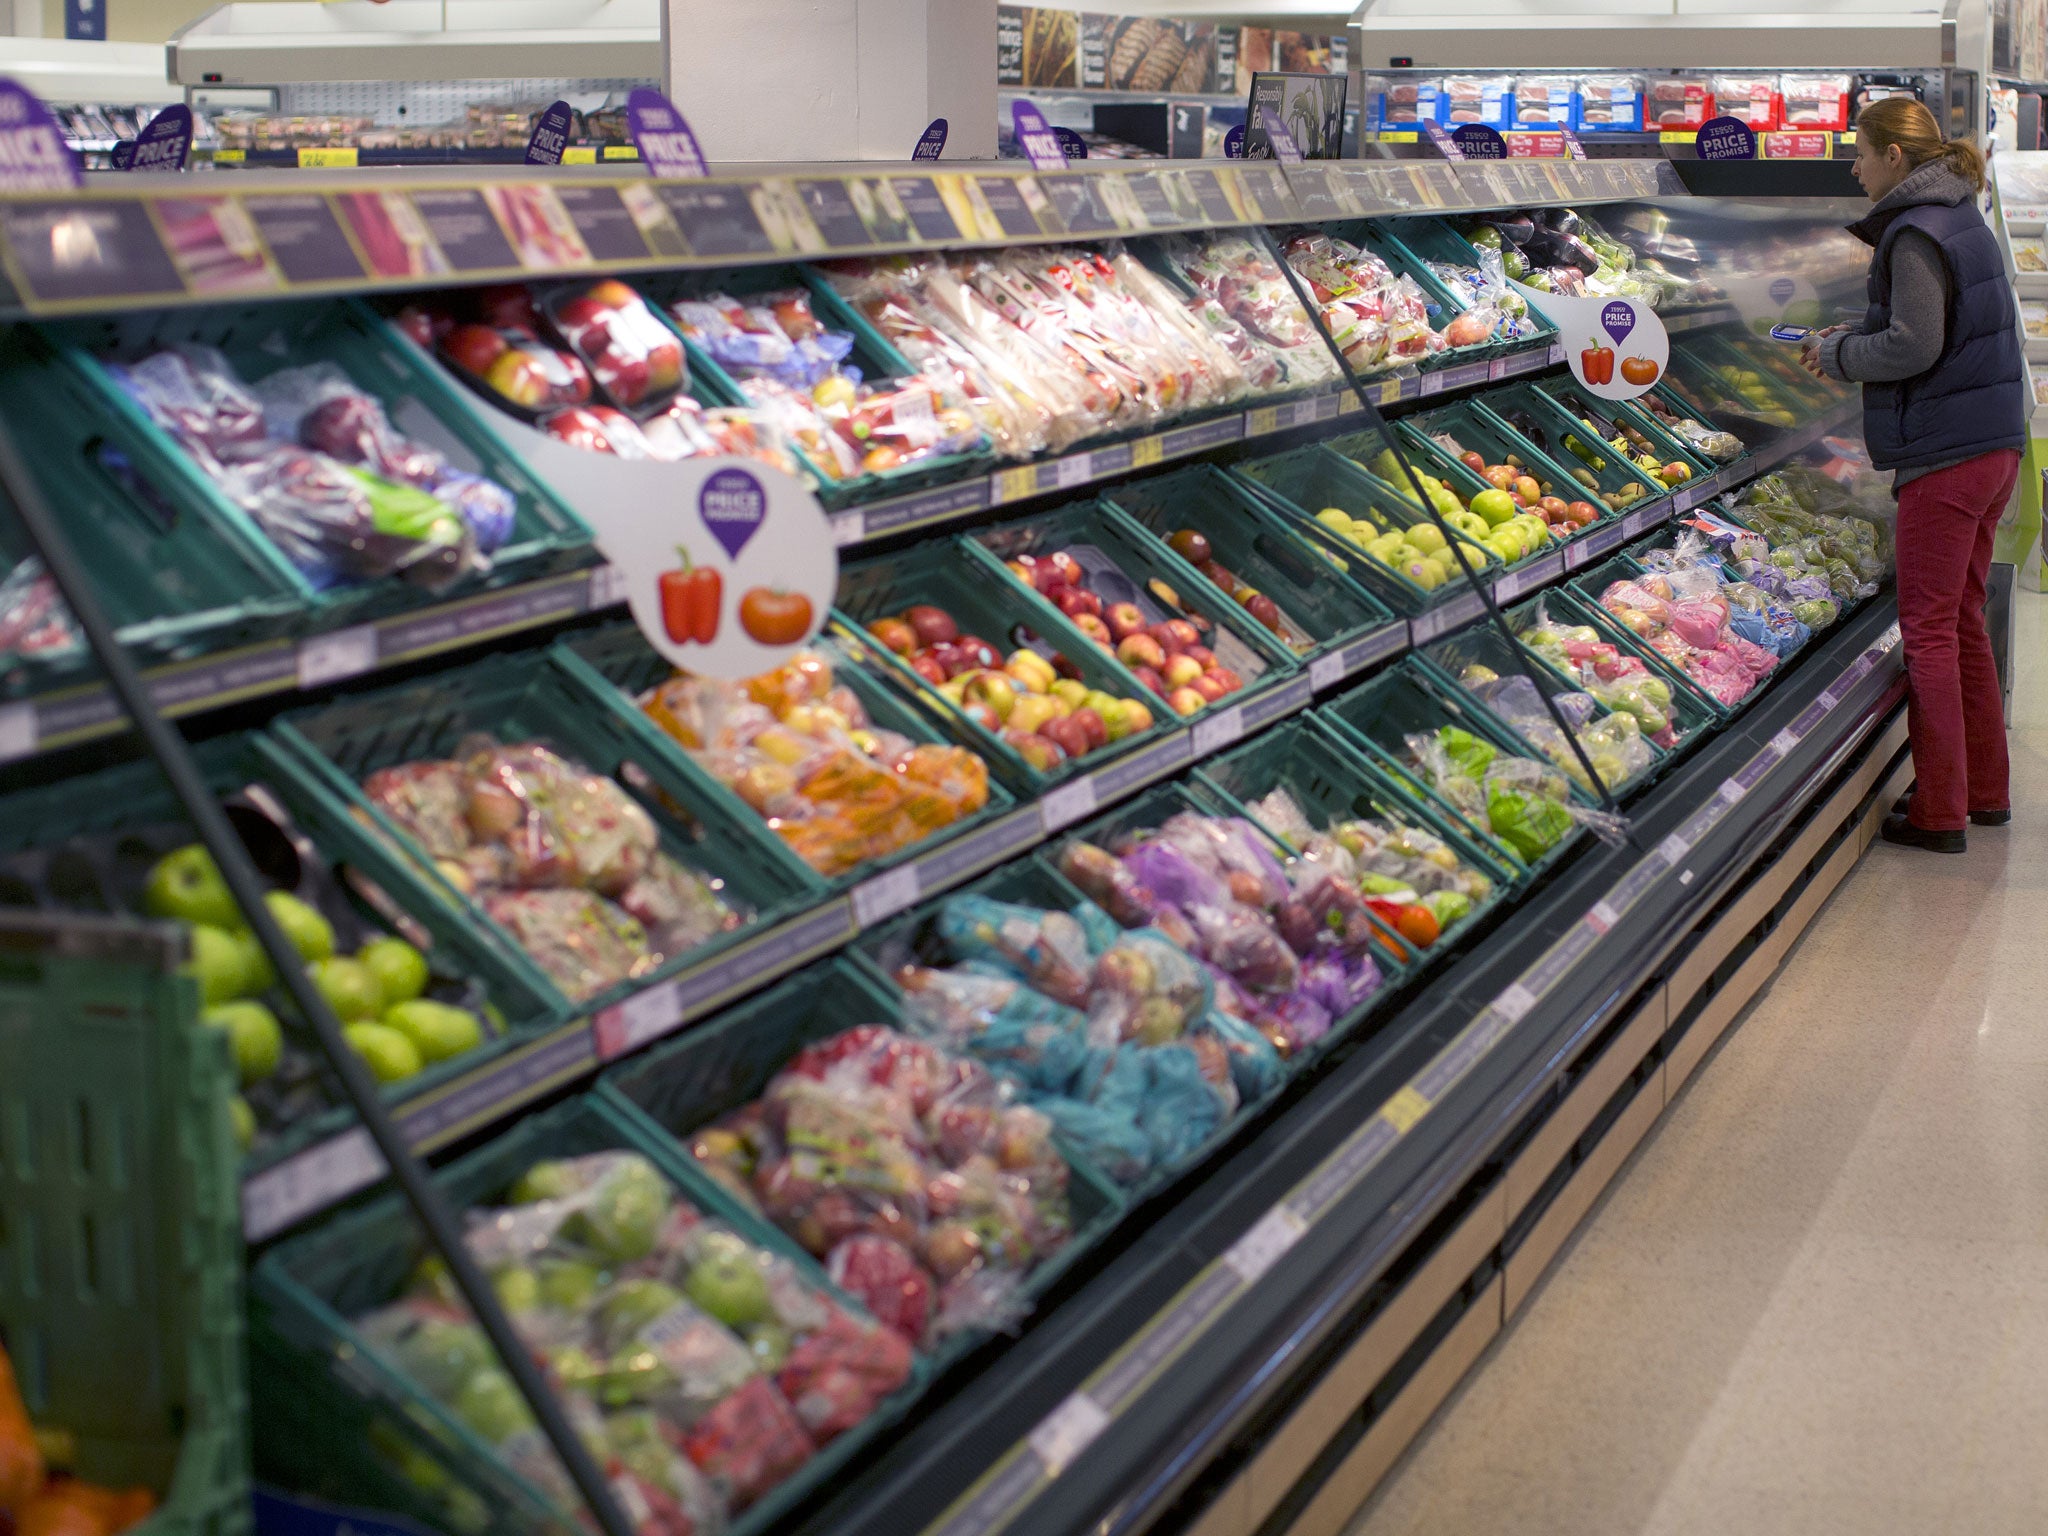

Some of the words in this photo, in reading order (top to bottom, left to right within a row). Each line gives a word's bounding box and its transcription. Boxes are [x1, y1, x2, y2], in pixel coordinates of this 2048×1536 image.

[1256, 86, 1283, 104] Responsibly
[1709, 124, 1734, 136] TESCO
[534, 128, 565, 152] PRICE
[1458, 142, 1500, 153] PRICE
[1702, 133, 1748, 152] PRICE
[133, 136, 186, 166] PRICE
[919, 142, 942, 156] PRICE
[1706, 146, 1750, 160] PROMISE
[1605, 313, 1632, 321] PRICE
[704, 490, 760, 507] PRICE
